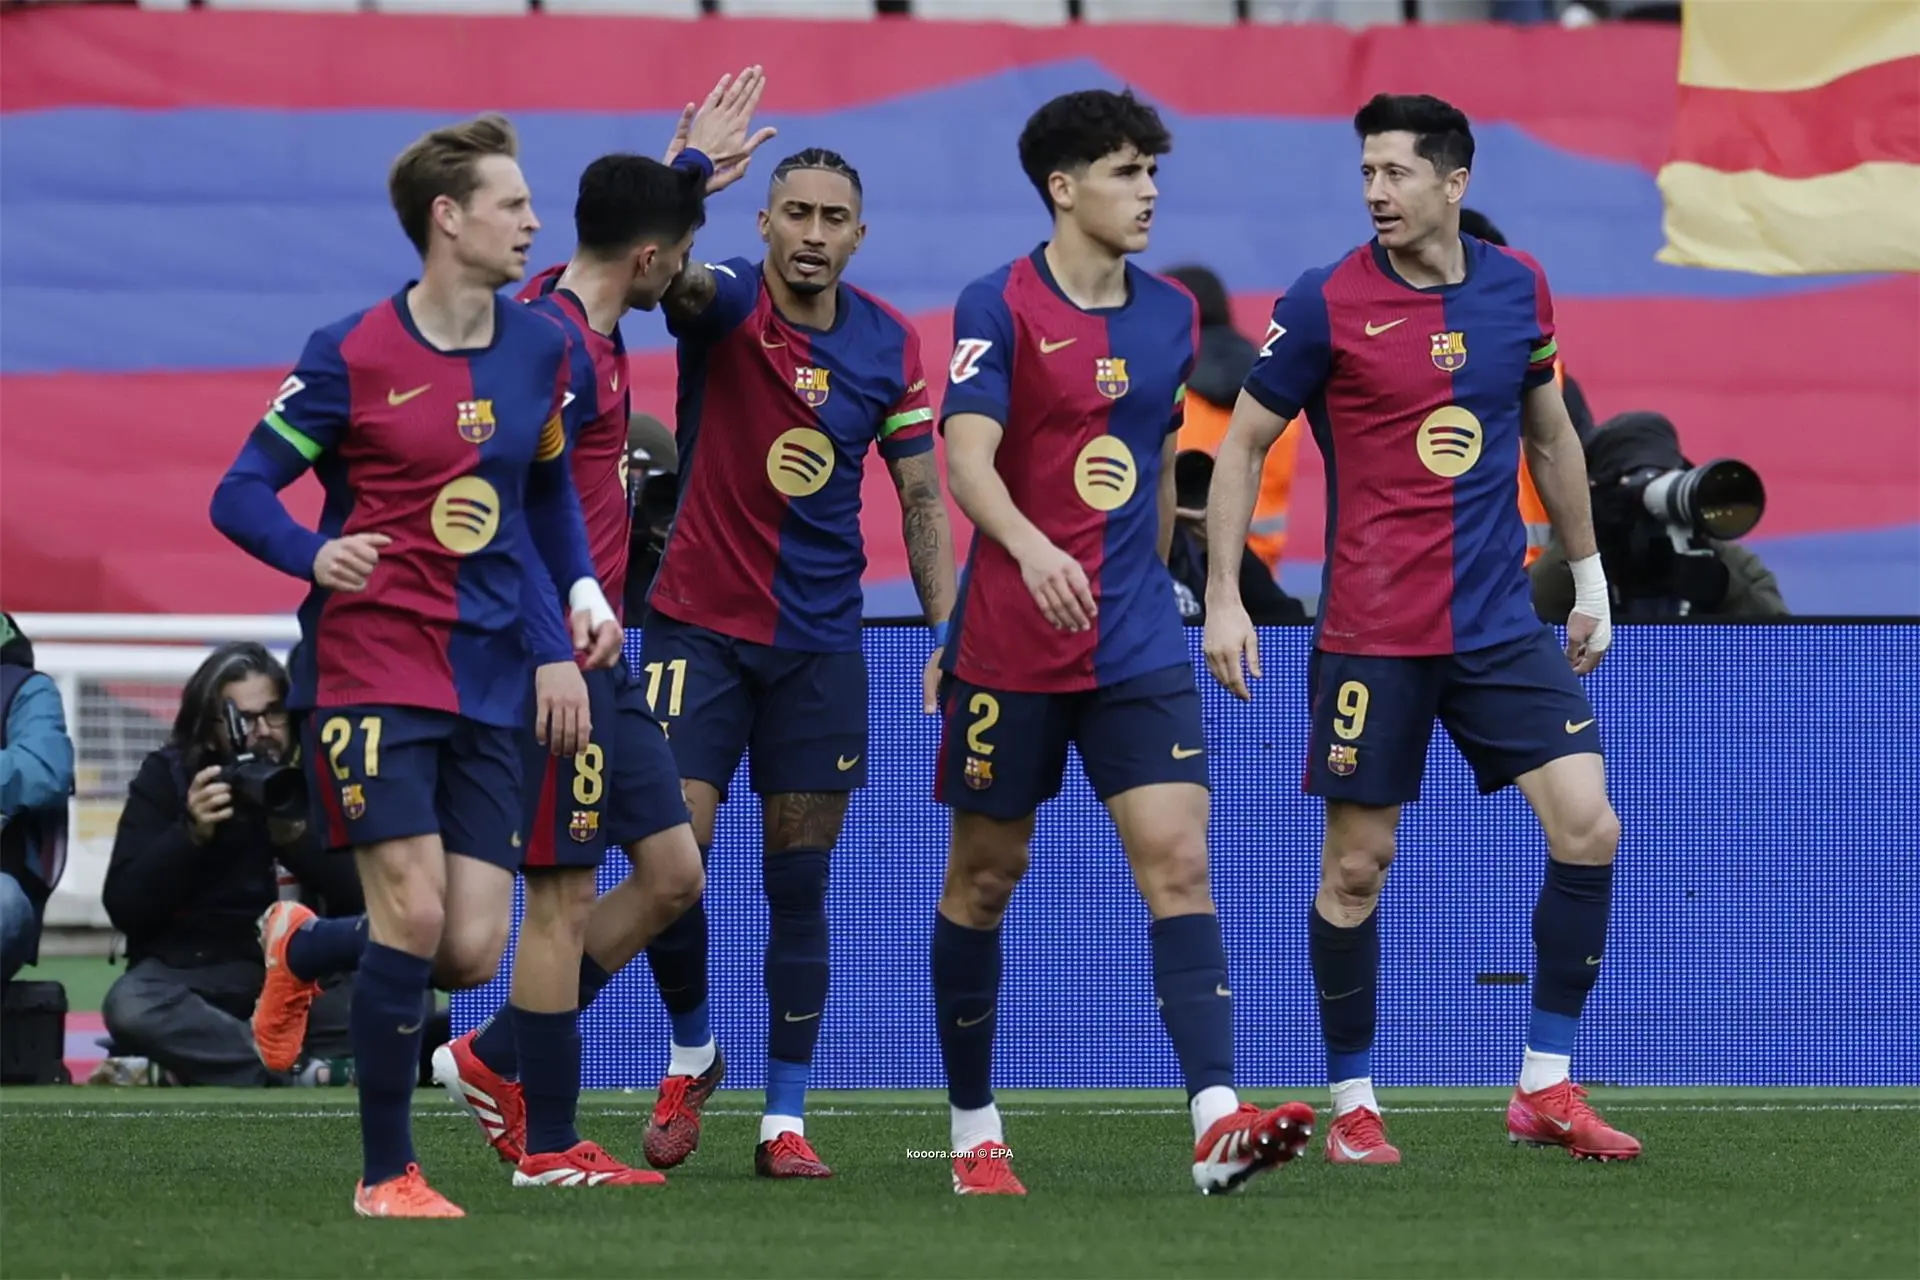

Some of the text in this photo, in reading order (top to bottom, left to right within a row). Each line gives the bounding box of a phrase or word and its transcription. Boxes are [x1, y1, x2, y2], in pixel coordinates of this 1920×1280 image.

[644, 659, 686, 715] 11
[1333, 680, 1369, 740] 9
[321, 716, 381, 780] 21
[967, 692, 999, 755] 2
[573, 744, 603, 805] 8
